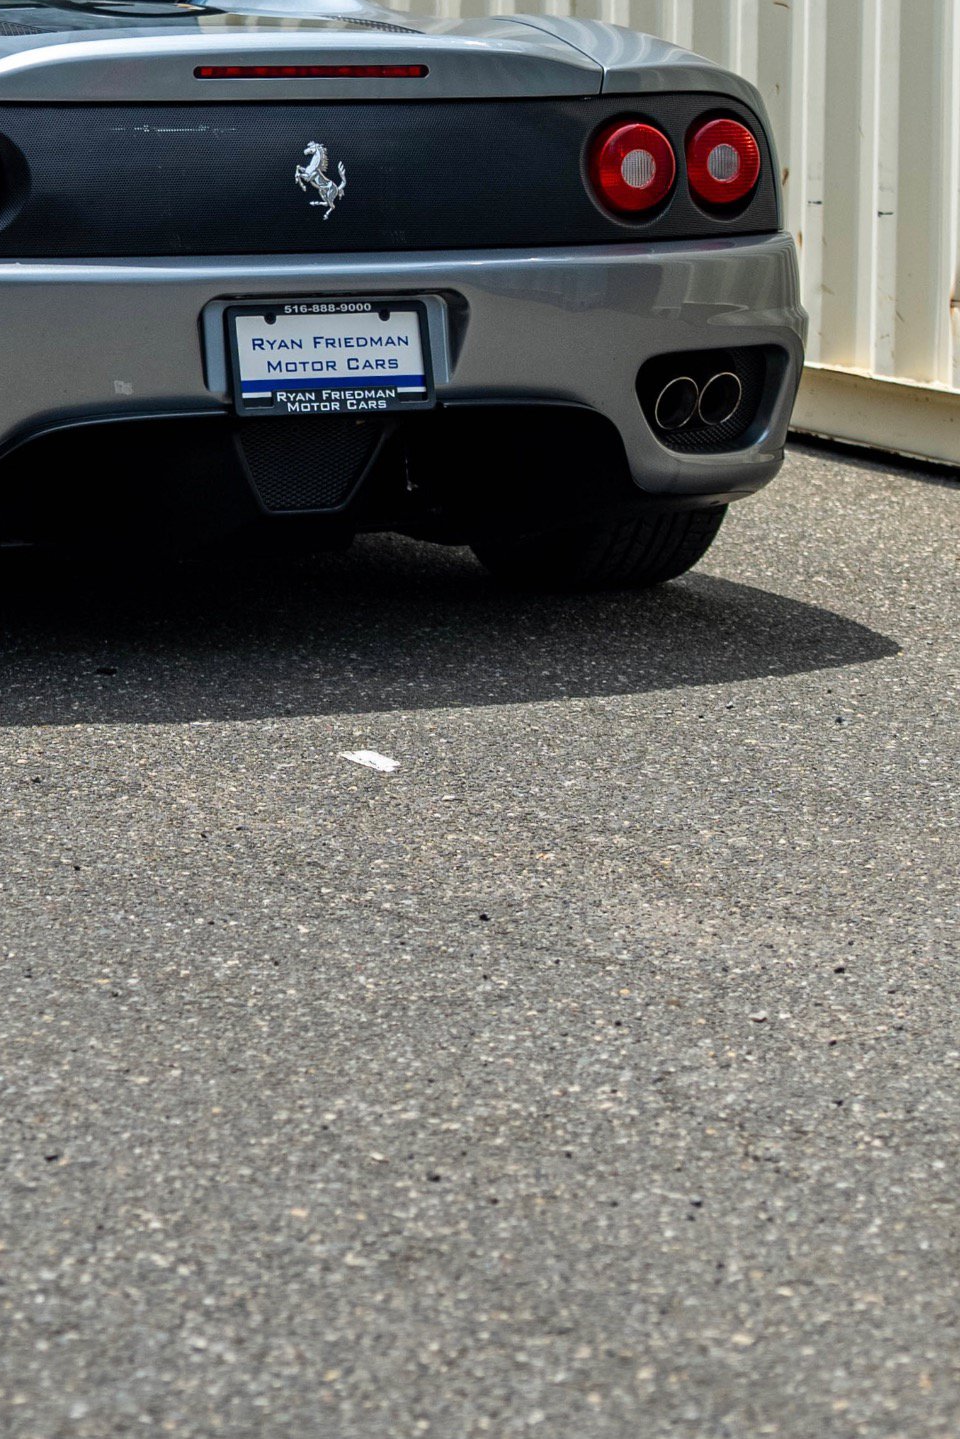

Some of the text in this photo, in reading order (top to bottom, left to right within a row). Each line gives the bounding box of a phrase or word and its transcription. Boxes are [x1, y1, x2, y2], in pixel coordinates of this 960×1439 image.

[284, 303, 372, 314] 516-888-9000
[252, 335, 409, 351] RYAN FRIEDMAN
[267, 357, 399, 373] MOTOR CARS
[276, 389, 396, 402] RYAN FRIEDMAN
[287, 399, 387, 412] MOTOR CARS
